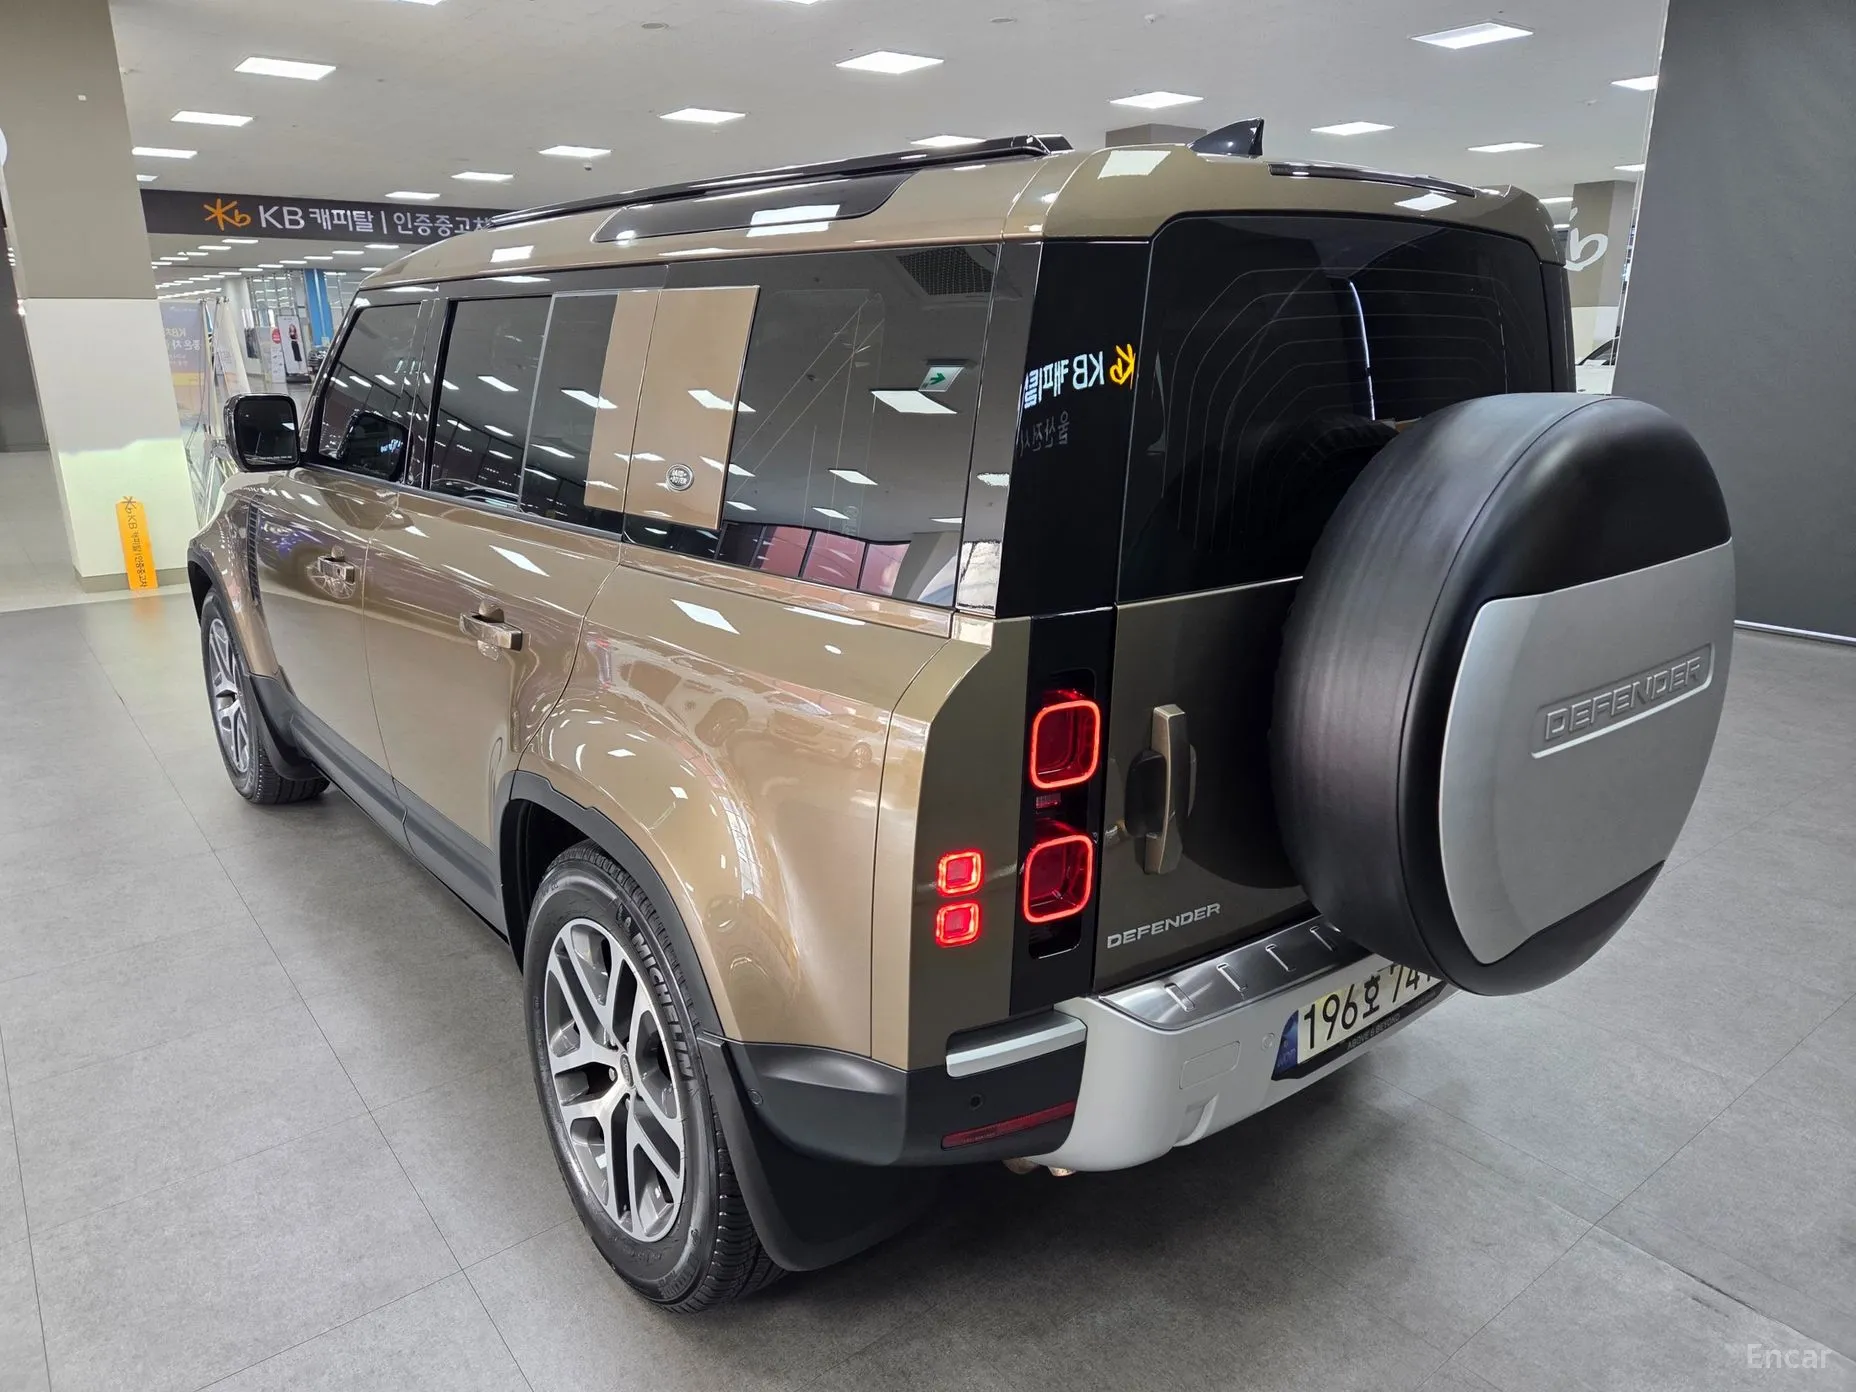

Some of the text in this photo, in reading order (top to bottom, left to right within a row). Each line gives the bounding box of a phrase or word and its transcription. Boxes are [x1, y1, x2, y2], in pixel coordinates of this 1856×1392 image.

[1544, 655, 1703, 742] DEFENDER
[1106, 902, 1222, 950] DEFENDER
[631, 931, 694, 1078] MICHELIN
[1303, 974, 1381, 1050] 196호
